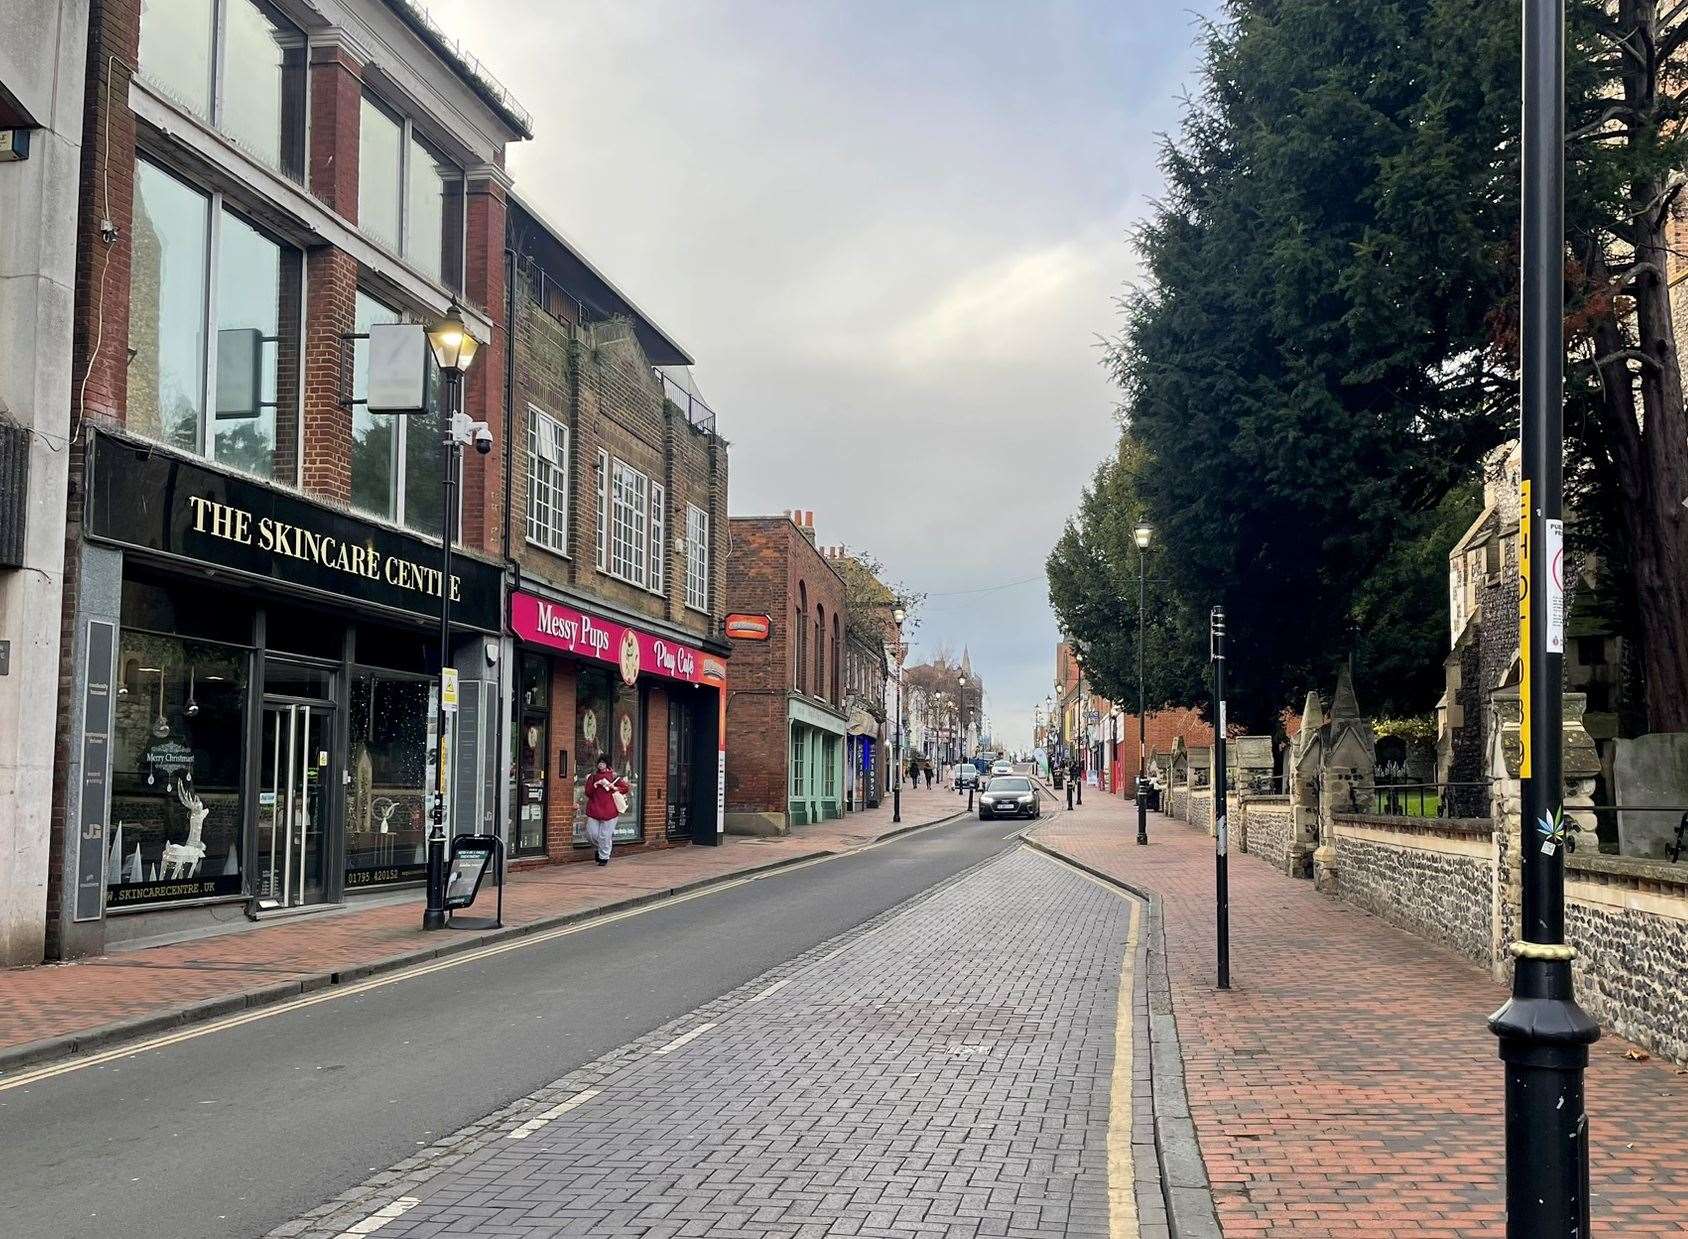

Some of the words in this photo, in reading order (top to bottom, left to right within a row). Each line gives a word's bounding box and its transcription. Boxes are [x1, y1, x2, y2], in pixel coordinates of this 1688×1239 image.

[189, 496, 252, 545] THE
[258, 517, 380, 580] SKINCARE
[537, 601, 578, 651] Messy
[581, 615, 609, 658] Pups
[654, 640, 675, 677] Play
[146, 752, 164, 765] Merry
